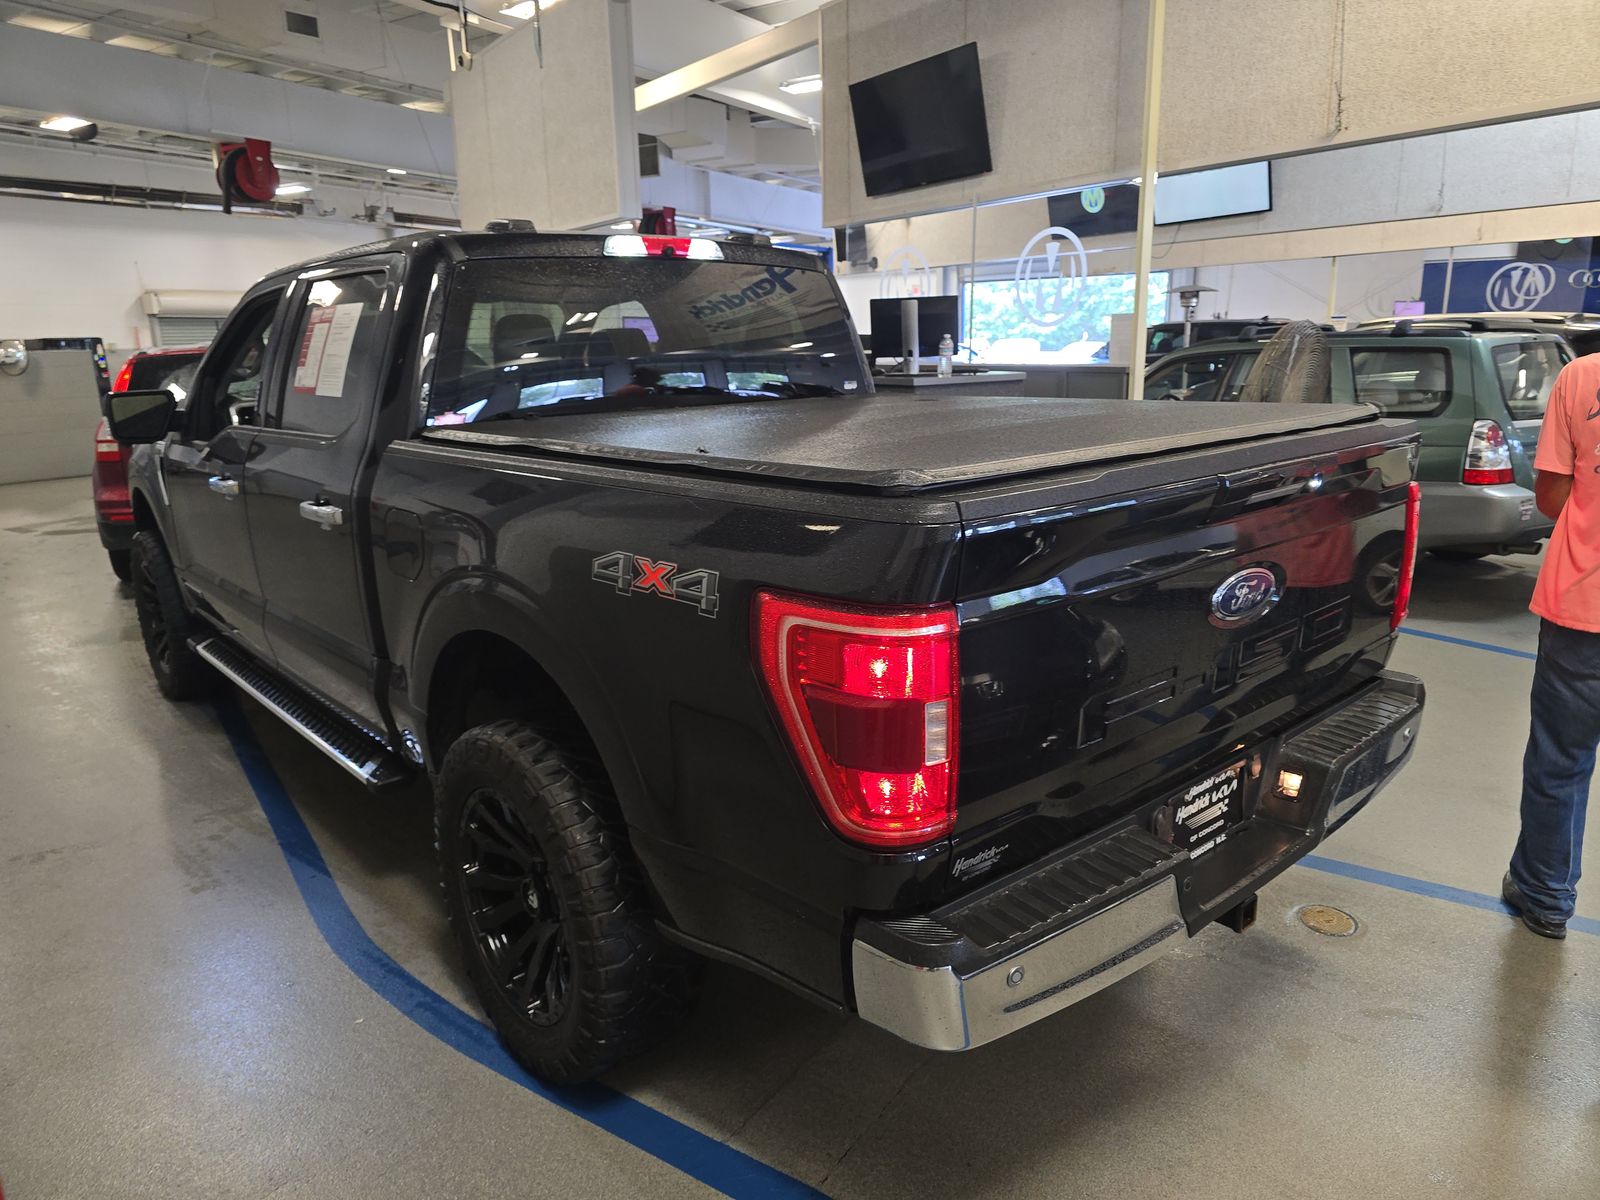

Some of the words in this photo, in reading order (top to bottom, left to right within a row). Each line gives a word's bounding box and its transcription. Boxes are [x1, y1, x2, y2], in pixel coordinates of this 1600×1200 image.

[1231, 579, 1265, 611] Ford
[1198, 819, 1225, 838] CONCORD
[951, 846, 997, 878] Hendrick
